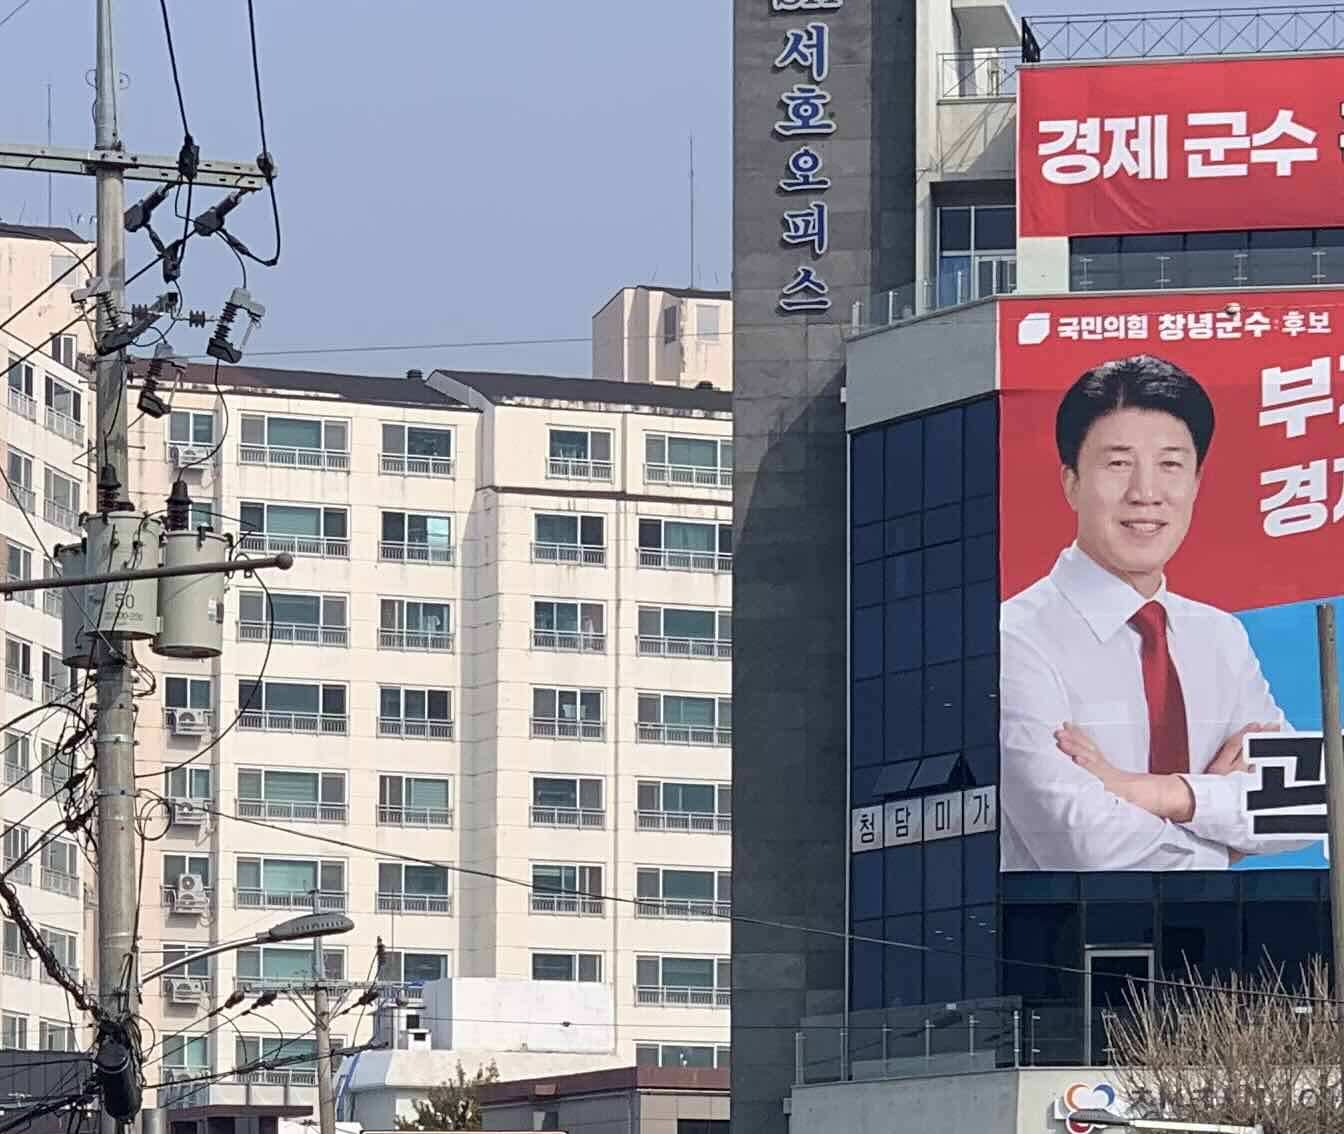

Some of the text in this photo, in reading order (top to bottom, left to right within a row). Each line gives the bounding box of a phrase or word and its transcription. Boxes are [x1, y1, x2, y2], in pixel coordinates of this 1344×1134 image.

[773, 0, 843, 310] 서호오피스
[1038, 113, 1167, 184] 경제
[1184, 112, 1317, 178] 군수
[1057, 311, 1332, 341] 국민의힘 창녕군수 후보
